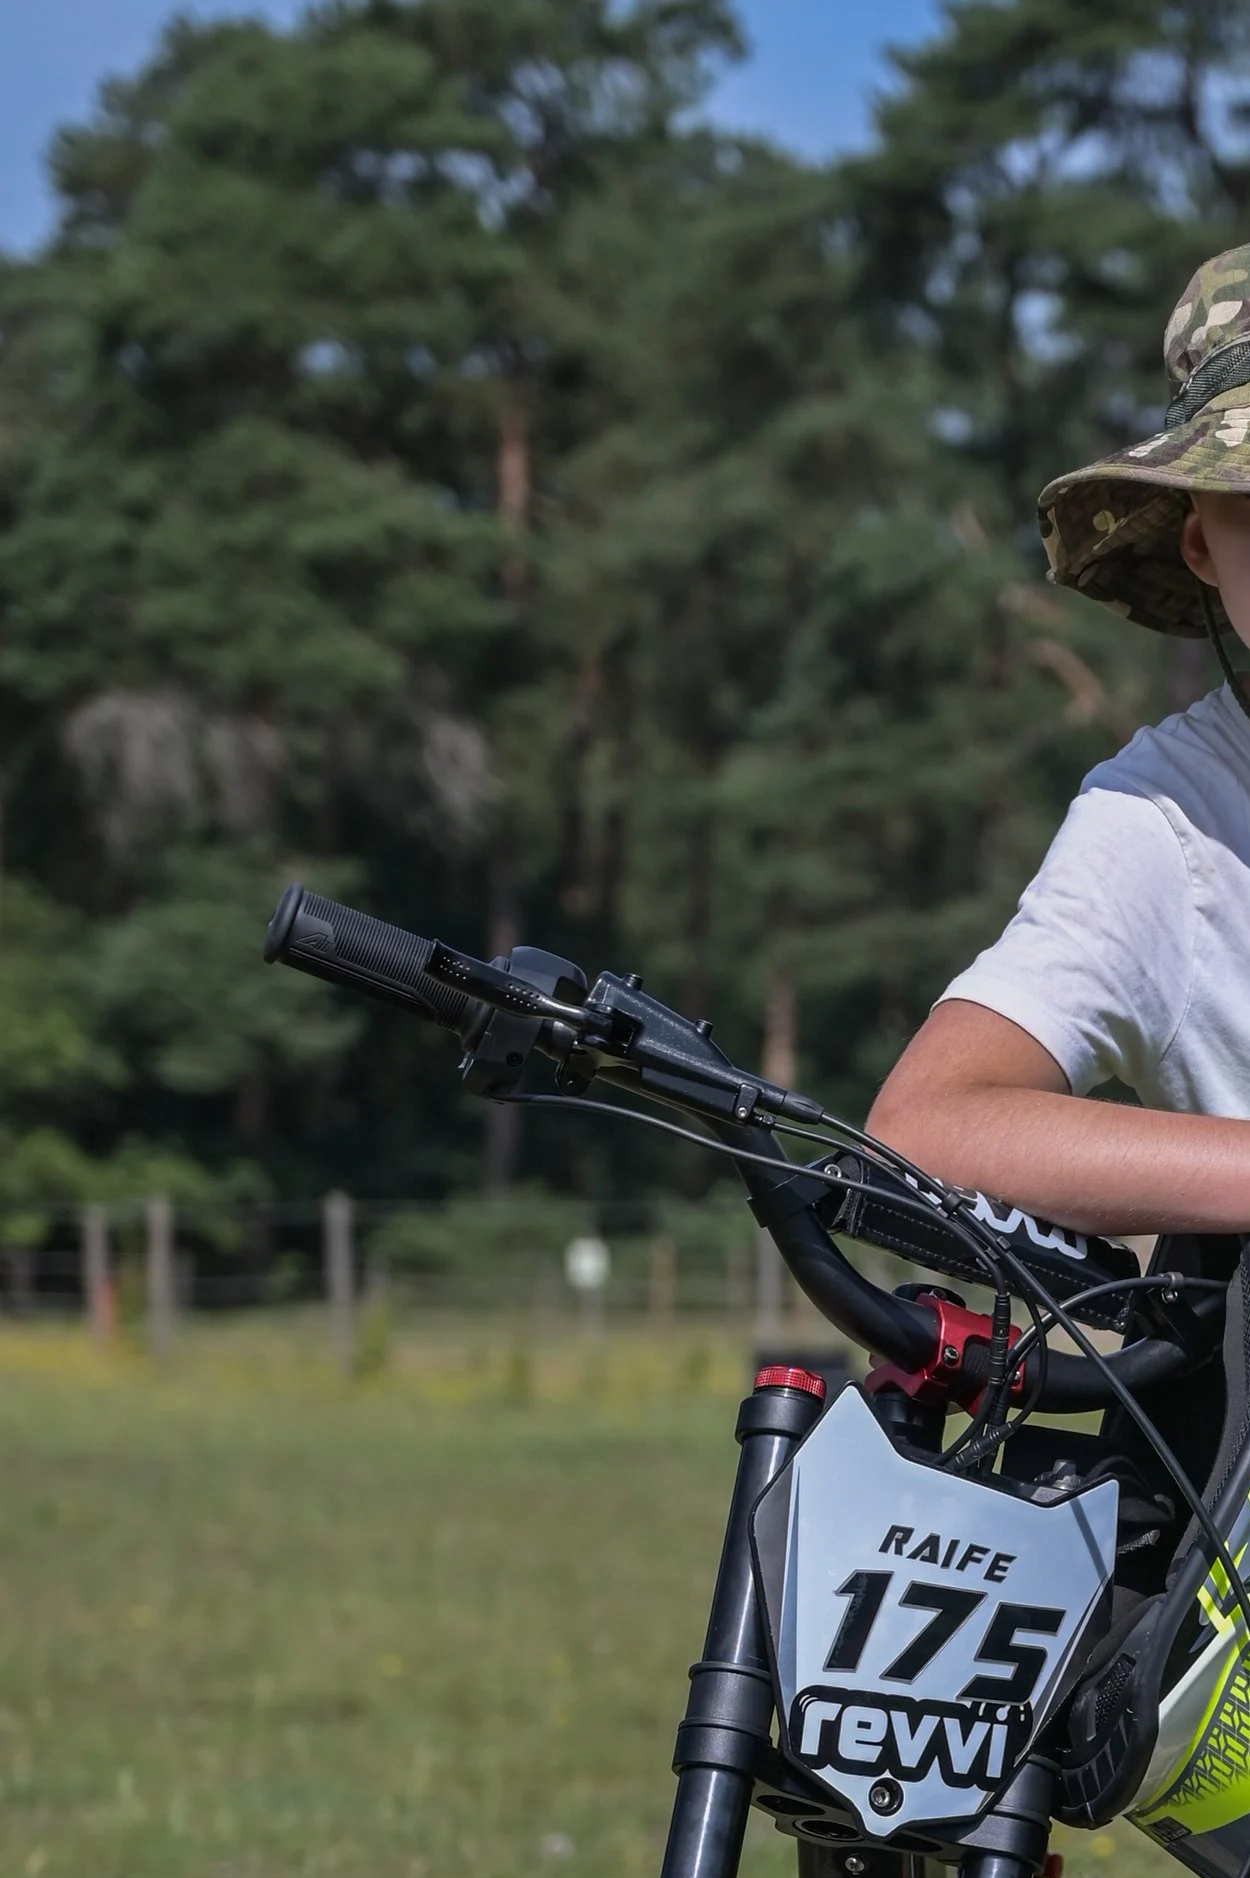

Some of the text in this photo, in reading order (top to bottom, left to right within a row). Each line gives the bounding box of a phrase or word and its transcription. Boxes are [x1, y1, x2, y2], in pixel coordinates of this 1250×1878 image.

[878, 1523, 1018, 1584] RAIFE
[821, 1568, 1067, 1704] 175
[799, 1700, 1010, 1780] revvi
